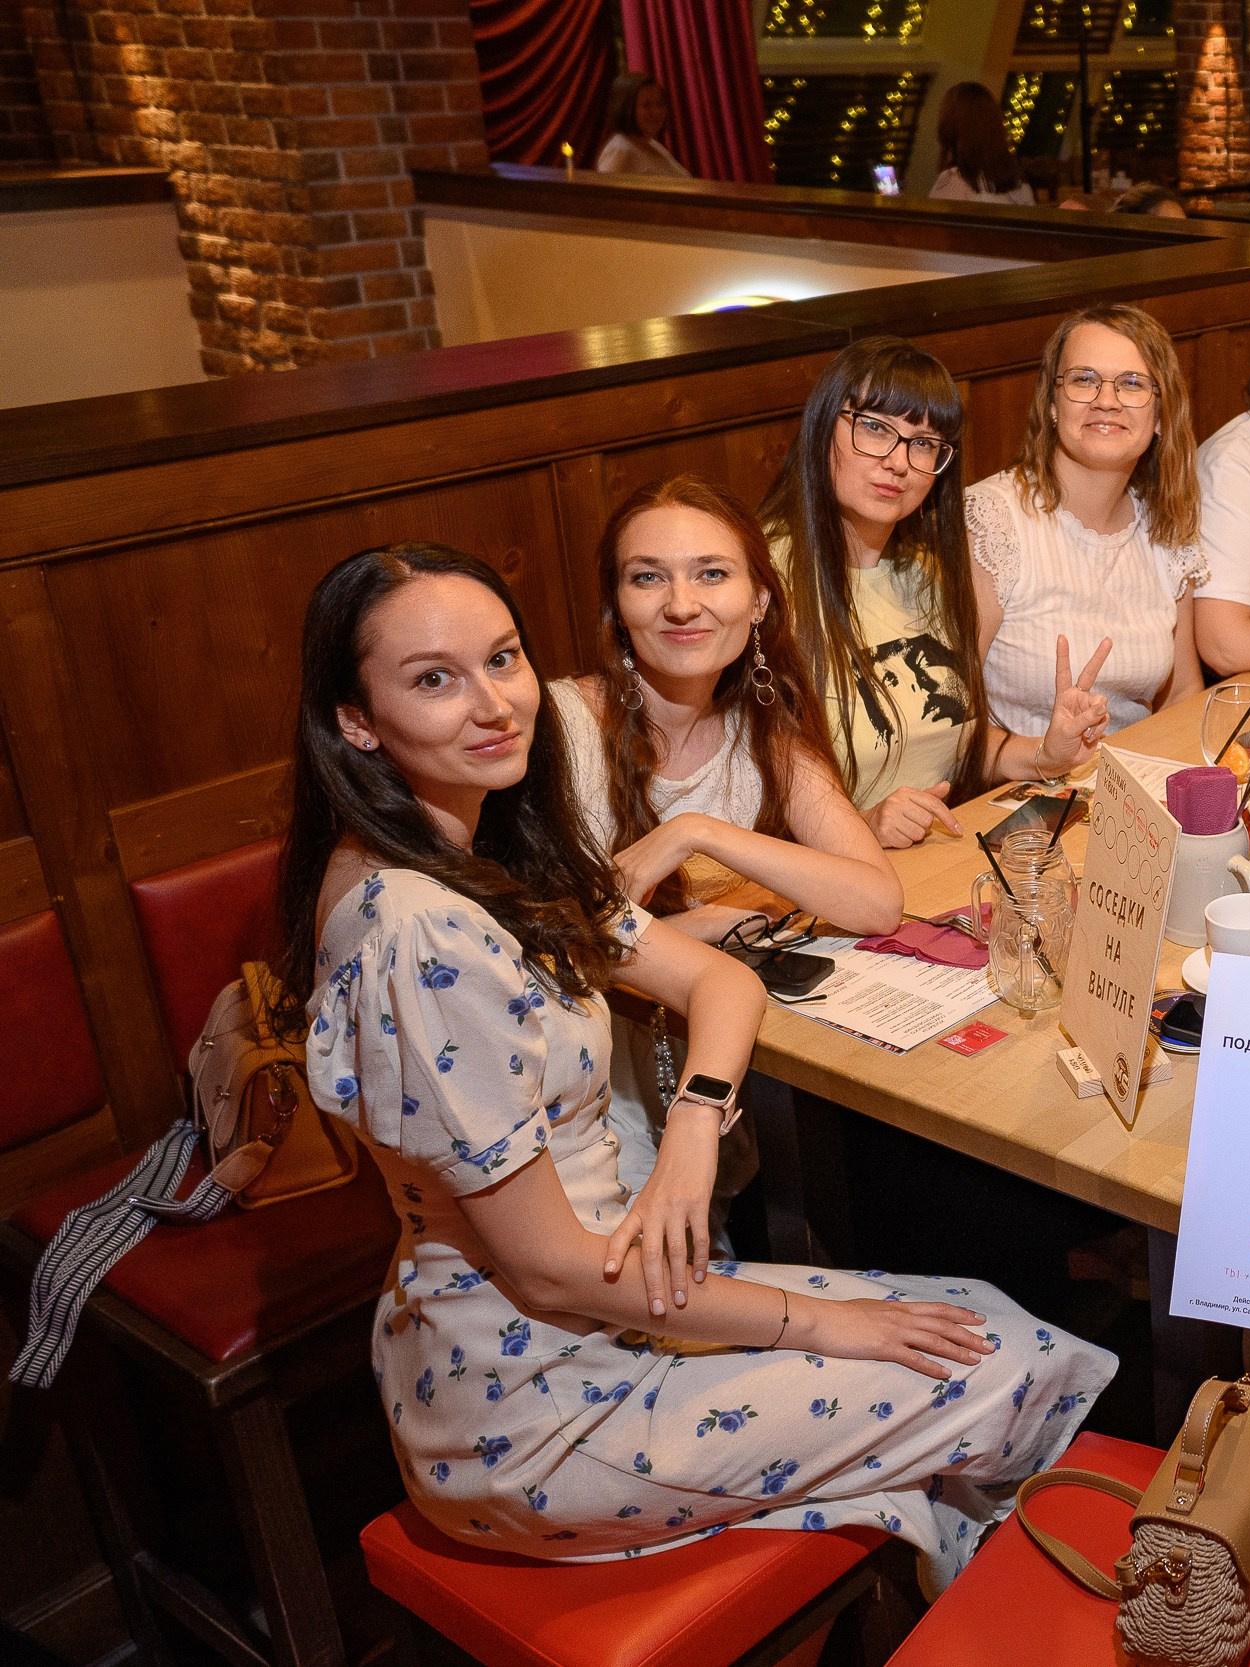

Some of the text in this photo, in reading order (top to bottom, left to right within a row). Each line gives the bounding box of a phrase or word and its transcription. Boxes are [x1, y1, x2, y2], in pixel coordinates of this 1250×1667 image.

[1089, 881, 1146, 930] СОСЕДКИ
[1104, 933, 1122, 966] НА
[1087, 969, 1136, 1019] ВЫГУЛЕ
[1195, 1299, 1231, 1312] Владимир,
[1231, 1306, 1242, 1314] ул.
